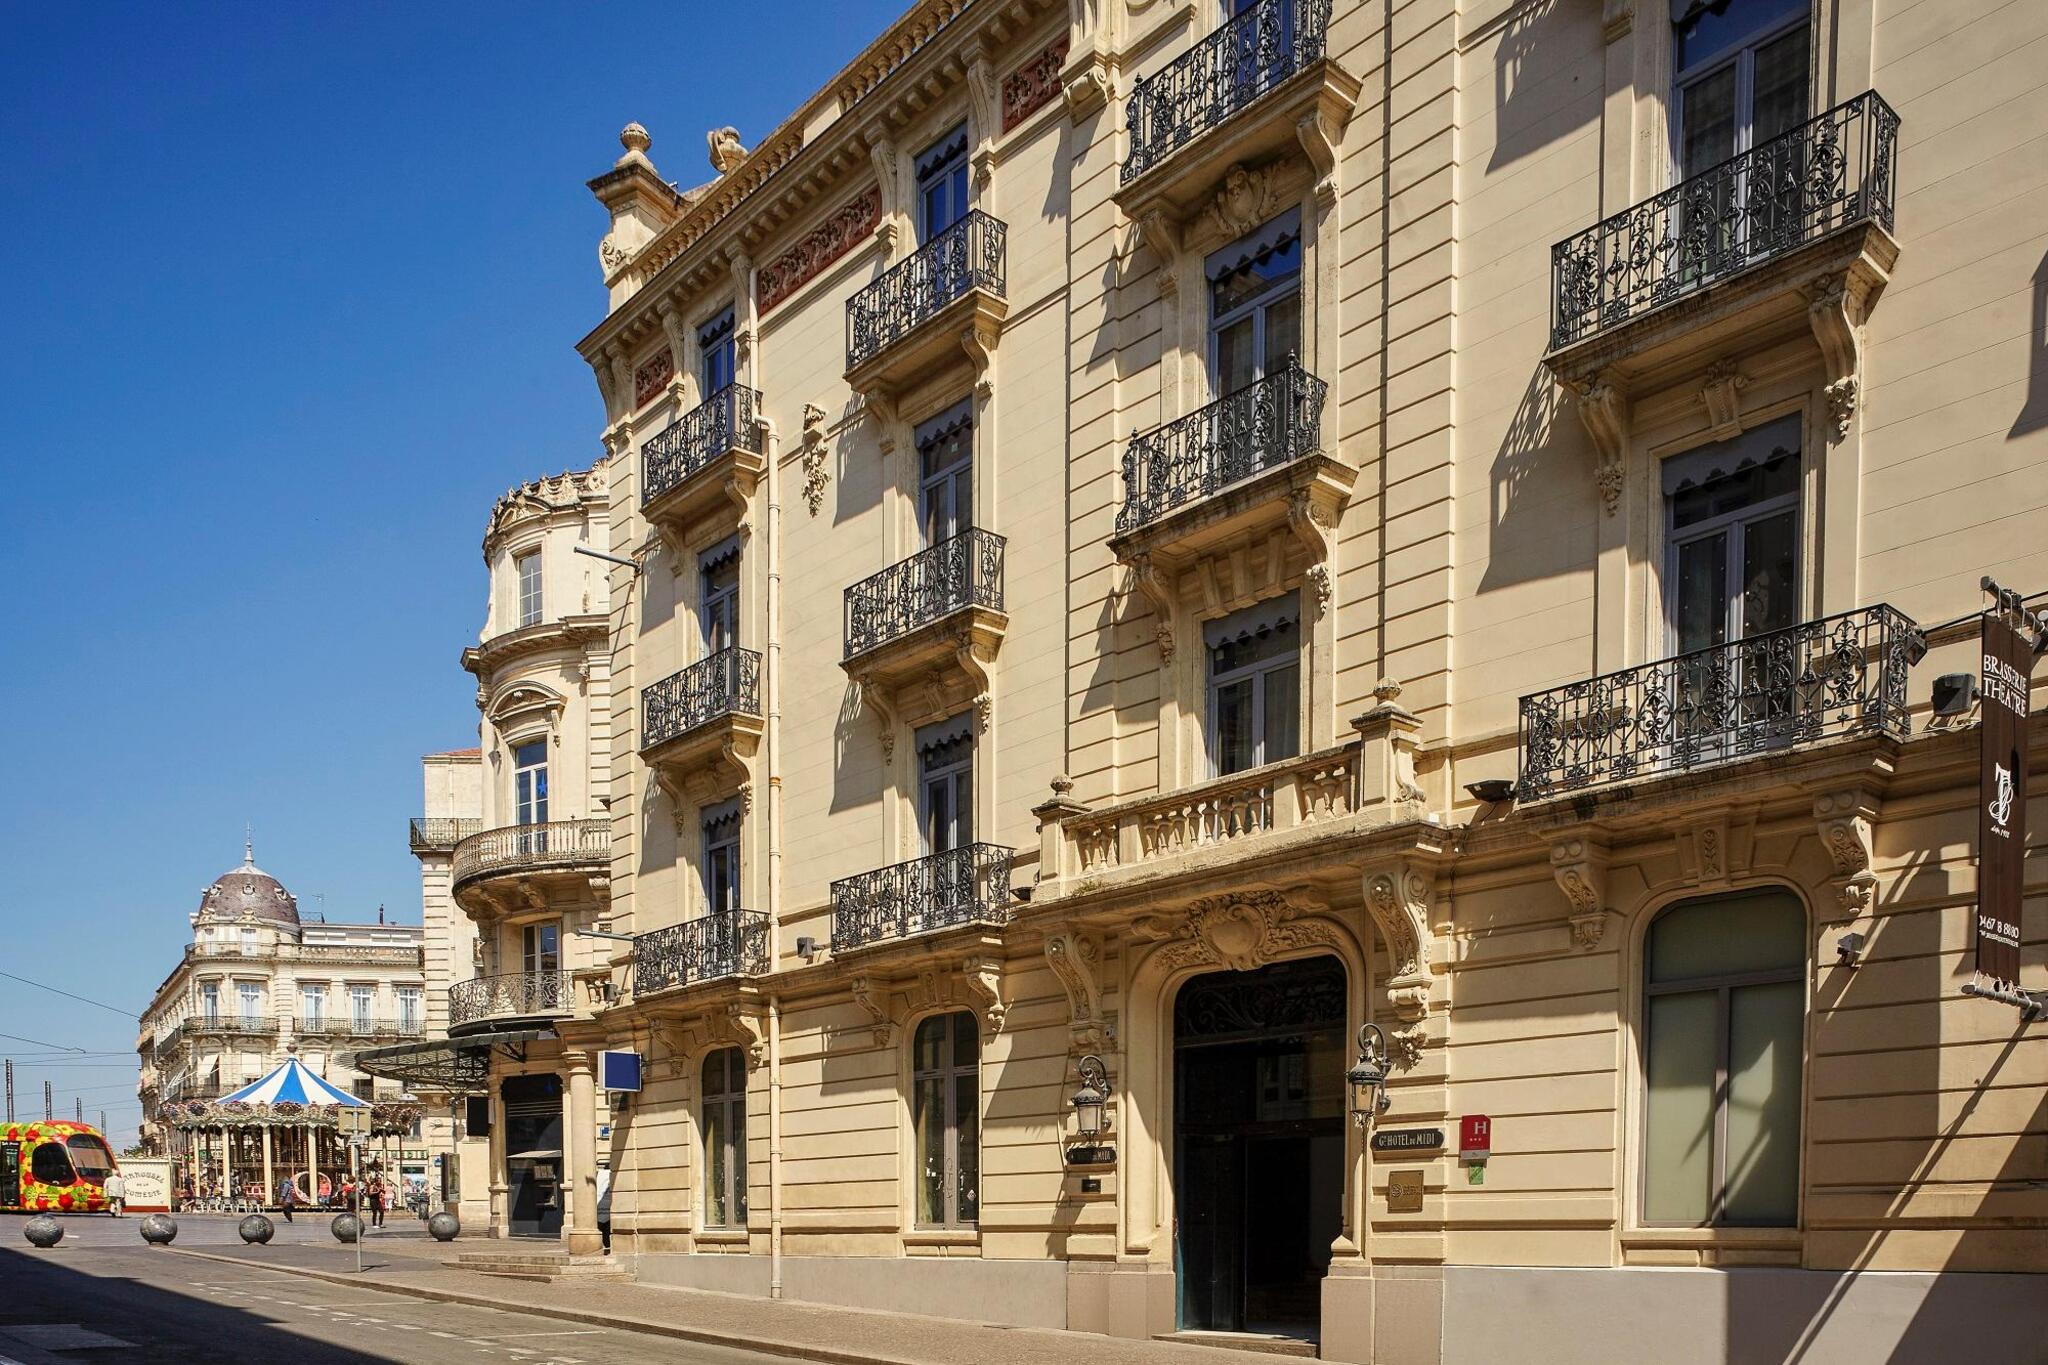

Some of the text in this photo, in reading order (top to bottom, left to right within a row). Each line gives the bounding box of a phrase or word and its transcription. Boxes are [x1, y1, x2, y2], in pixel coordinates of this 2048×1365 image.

[1983, 654, 2027, 694] BRASSERIE
[1474, 1121, 1487, 1134] H
[1387, 1133, 1409, 1146] HOTEL
[1416, 1133, 1435, 1145] MIDI
